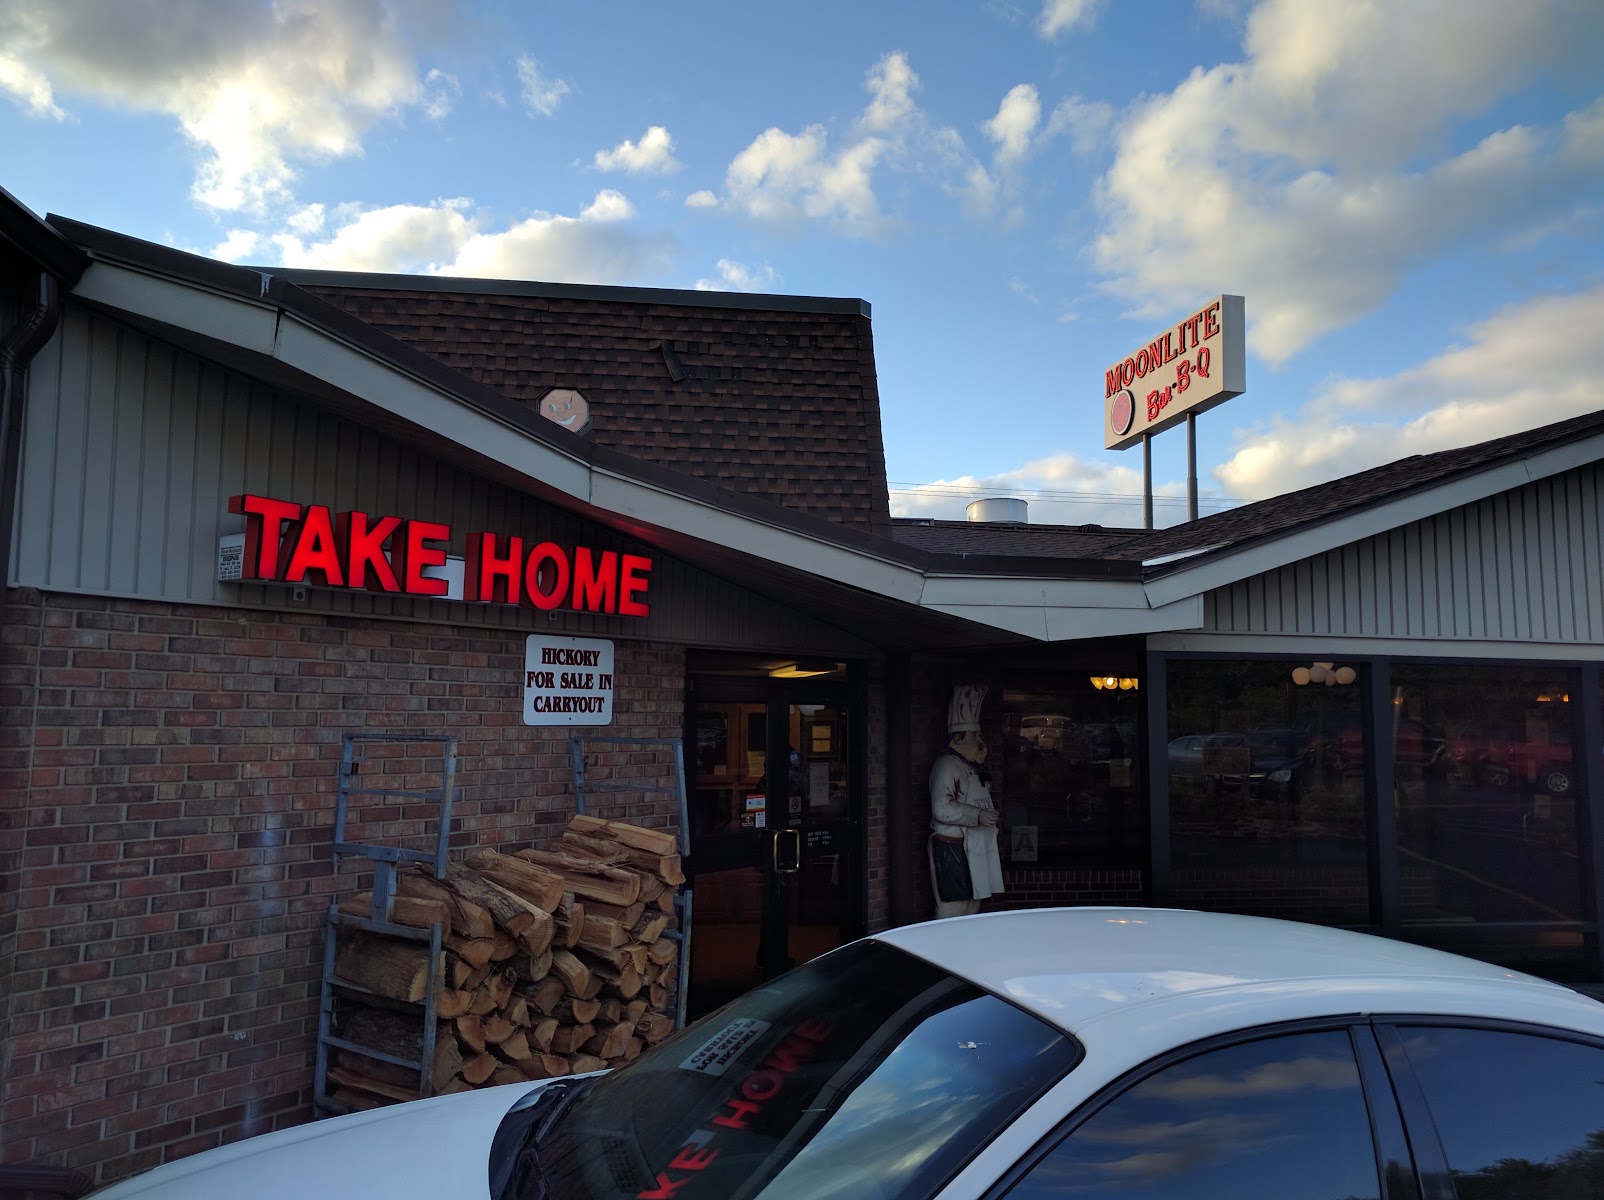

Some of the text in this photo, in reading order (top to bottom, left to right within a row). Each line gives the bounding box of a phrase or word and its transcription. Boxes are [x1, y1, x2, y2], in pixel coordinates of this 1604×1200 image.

[1105, 301, 1219, 399] MOONLITE
[231, 494, 653, 617] TAKE HOME
[541, 647, 601, 667] HICKORY
[526, 671, 613, 690] FOR SALE IN
[533, 695, 605, 714] CARRYOUT
